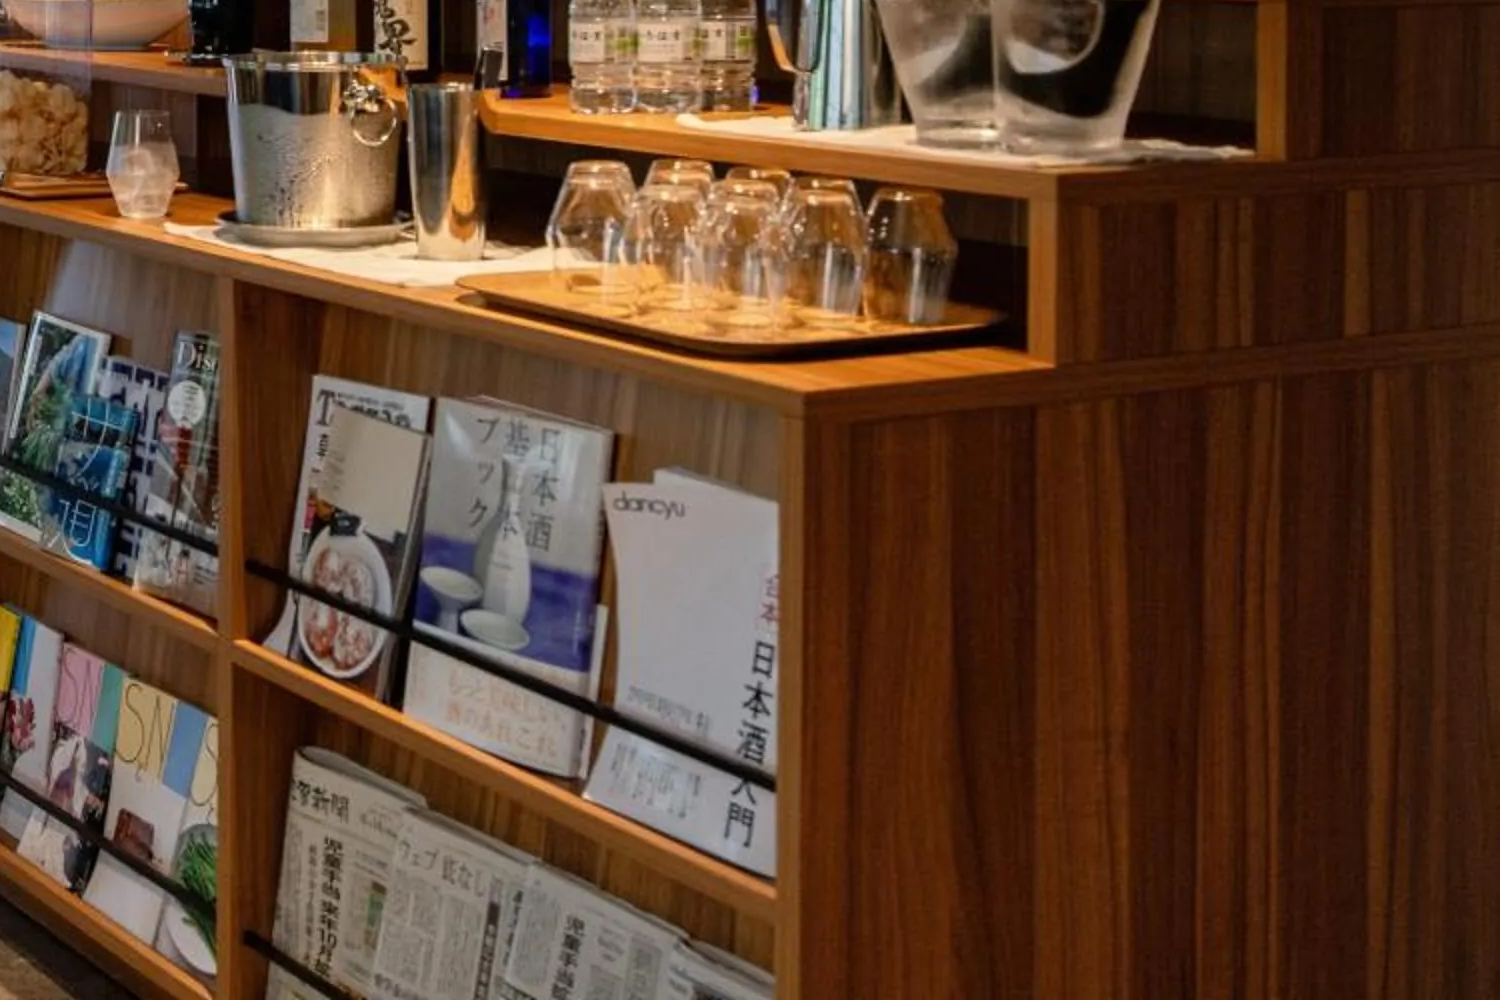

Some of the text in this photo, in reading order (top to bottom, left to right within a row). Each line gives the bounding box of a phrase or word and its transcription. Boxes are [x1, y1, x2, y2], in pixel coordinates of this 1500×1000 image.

[526, 427, 562, 552] 日本酒
[723, 640, 776, 849] 日本酒入門
